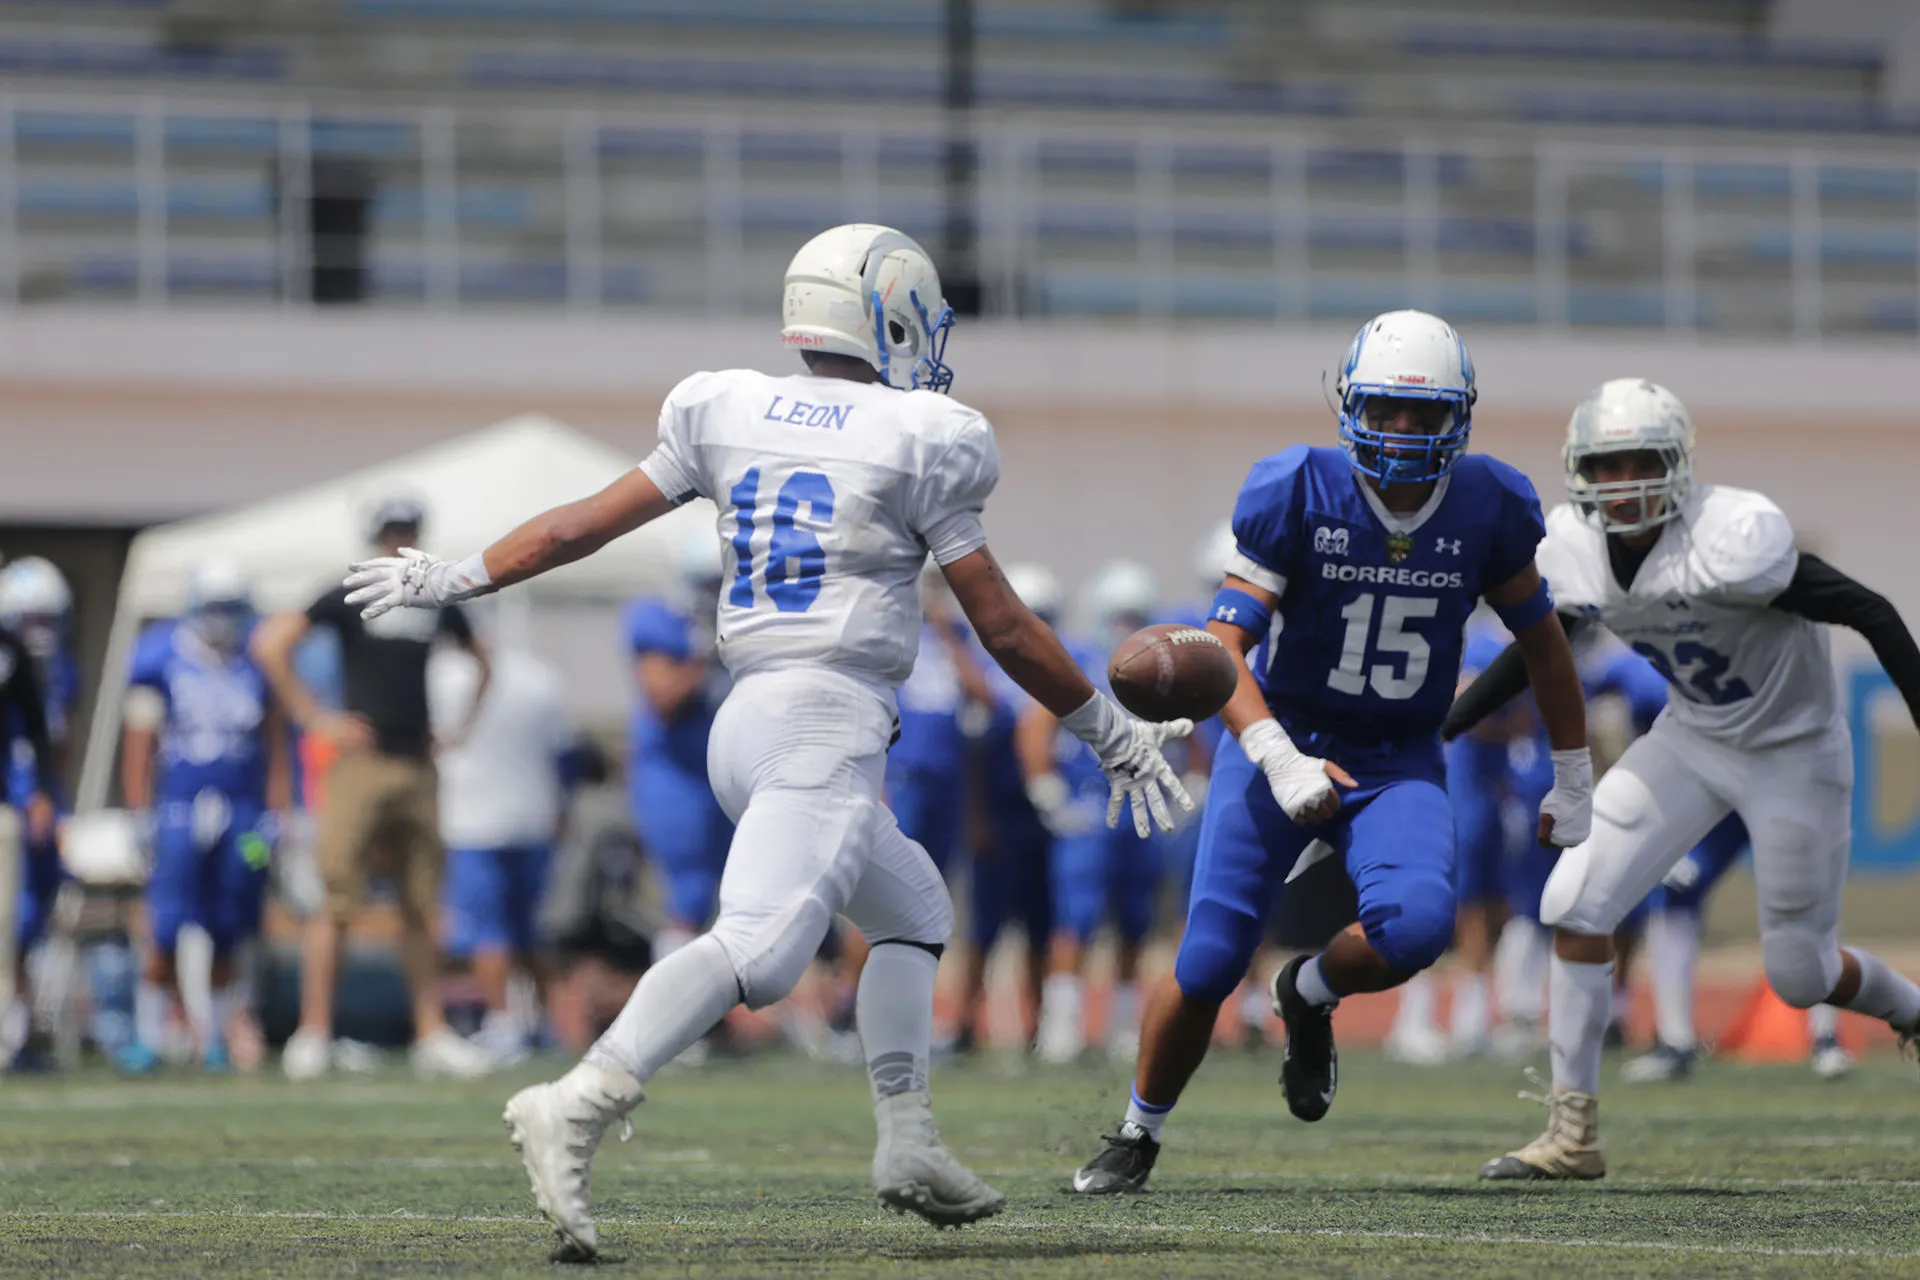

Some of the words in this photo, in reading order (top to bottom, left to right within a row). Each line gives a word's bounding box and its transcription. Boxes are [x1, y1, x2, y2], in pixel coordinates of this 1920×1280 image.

[765, 396, 854, 430] LEON
[730, 467, 835, 612] 16
[1322, 562, 1463, 588] BORREGOS
[1326, 593, 1439, 699] 15
